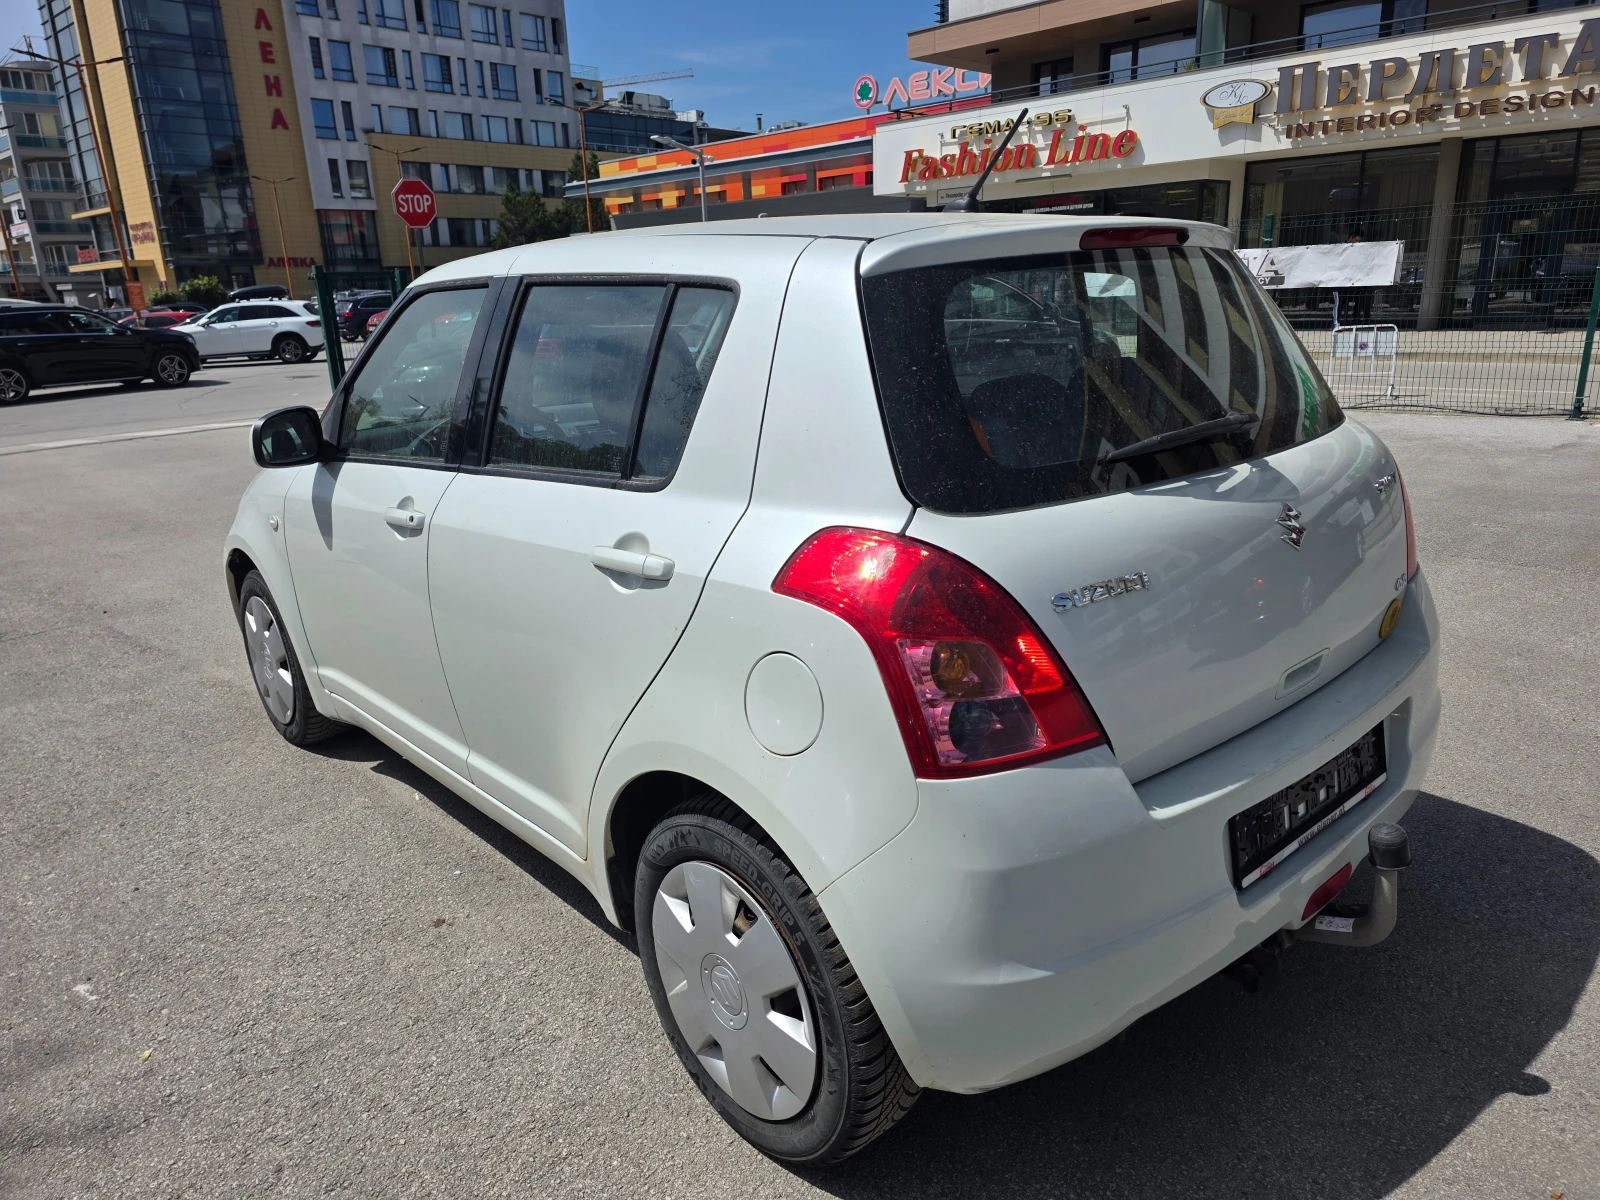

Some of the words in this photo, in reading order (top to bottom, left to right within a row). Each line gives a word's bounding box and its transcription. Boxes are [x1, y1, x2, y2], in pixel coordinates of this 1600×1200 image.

[254, 7, 289, 131] ЛЕНА
[1274, 17, 1600, 115] ПЕРДЕТА
[1286, 106, 1437, 139] INTERIOR
[1453, 86, 1596, 119] DESIGN
[898, 138, 1036, 183] Fashion
[1044, 125, 1138, 167] Line
[398, 194, 432, 213] STOP
[268, 256, 317, 268] АПТЕКА
[1051, 570, 1150, 613] SUZUKI
[714, 839, 795, 926] SPEED-GRIP
[792, 931, 806, 947] 5
